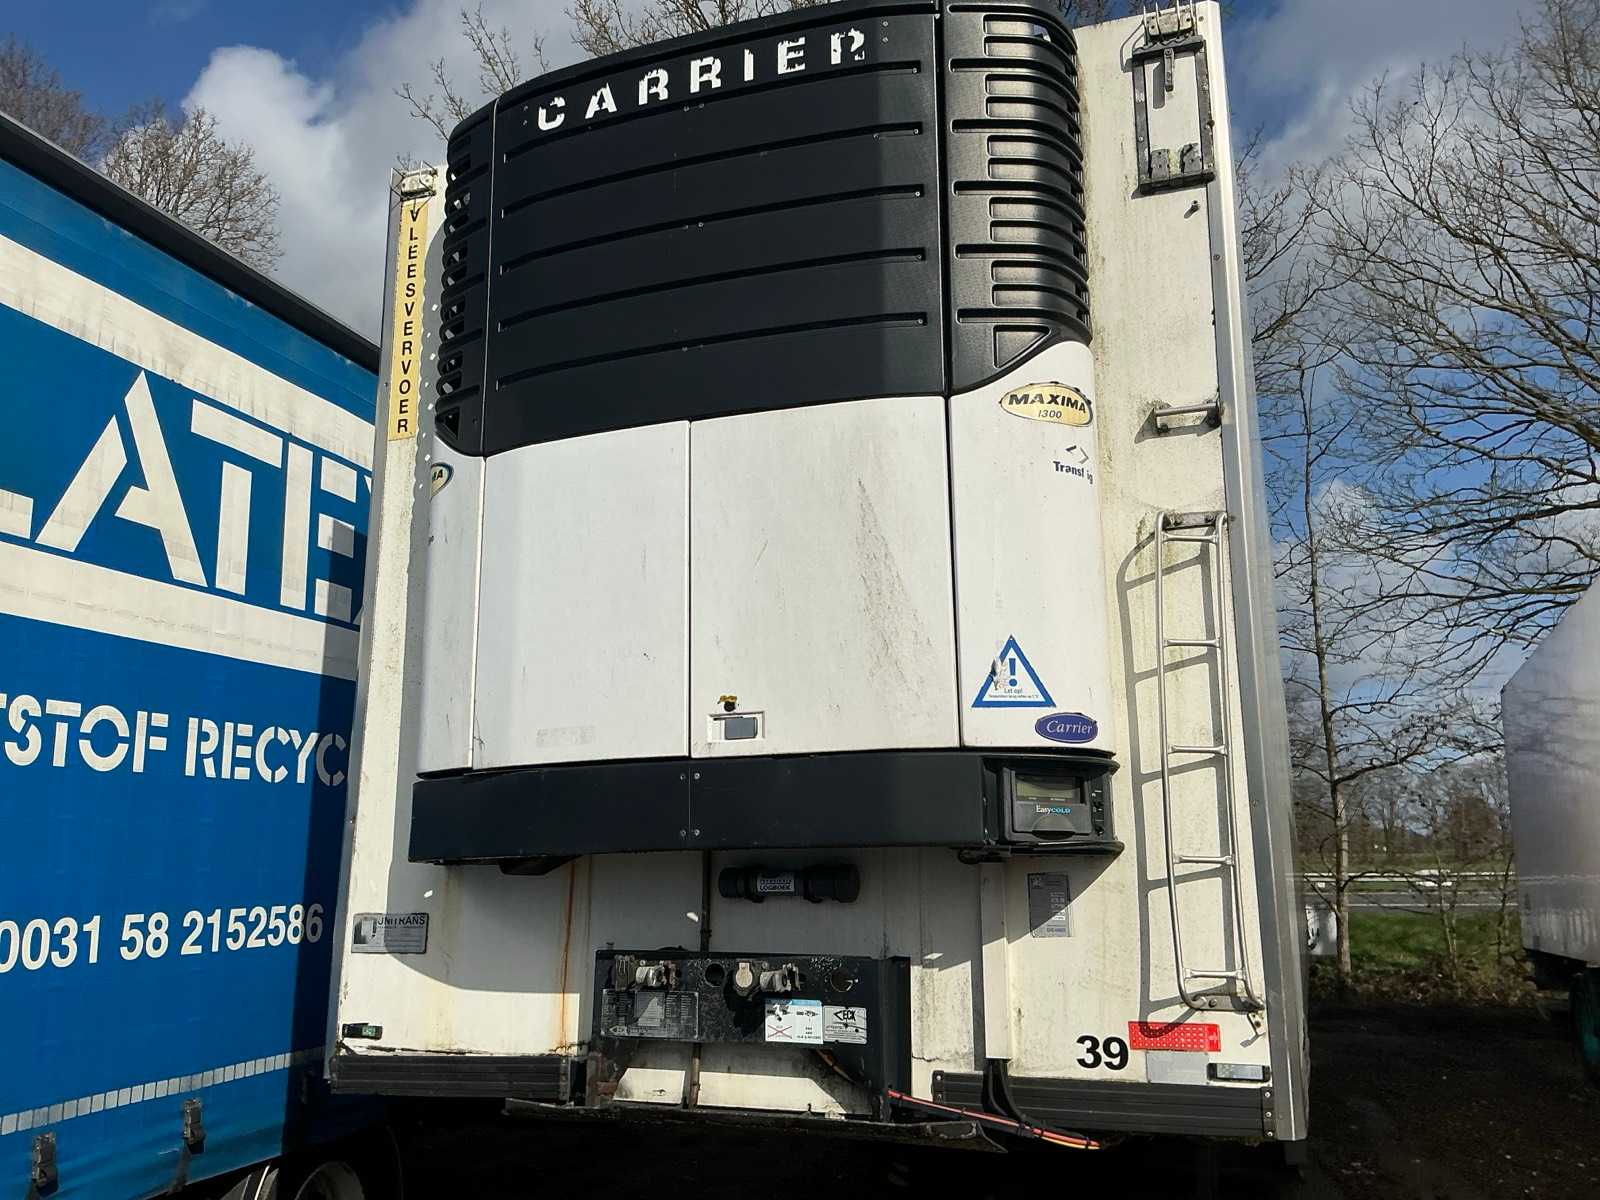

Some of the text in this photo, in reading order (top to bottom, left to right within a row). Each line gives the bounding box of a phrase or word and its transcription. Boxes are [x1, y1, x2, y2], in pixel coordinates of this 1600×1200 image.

[538, 28, 865, 131] CARRIER
[397, 210, 419, 433] VLEESVERVOER
[1008, 393, 1086, 414] MAXIMA
[1038, 409, 1062, 419] 1300
[0, 693, 169, 772] STOF
[1046, 720, 1093, 734] Carrier
[0, 903, 323, 973] 0031 58 2152586
[1076, 1034, 1128, 1071] 39
